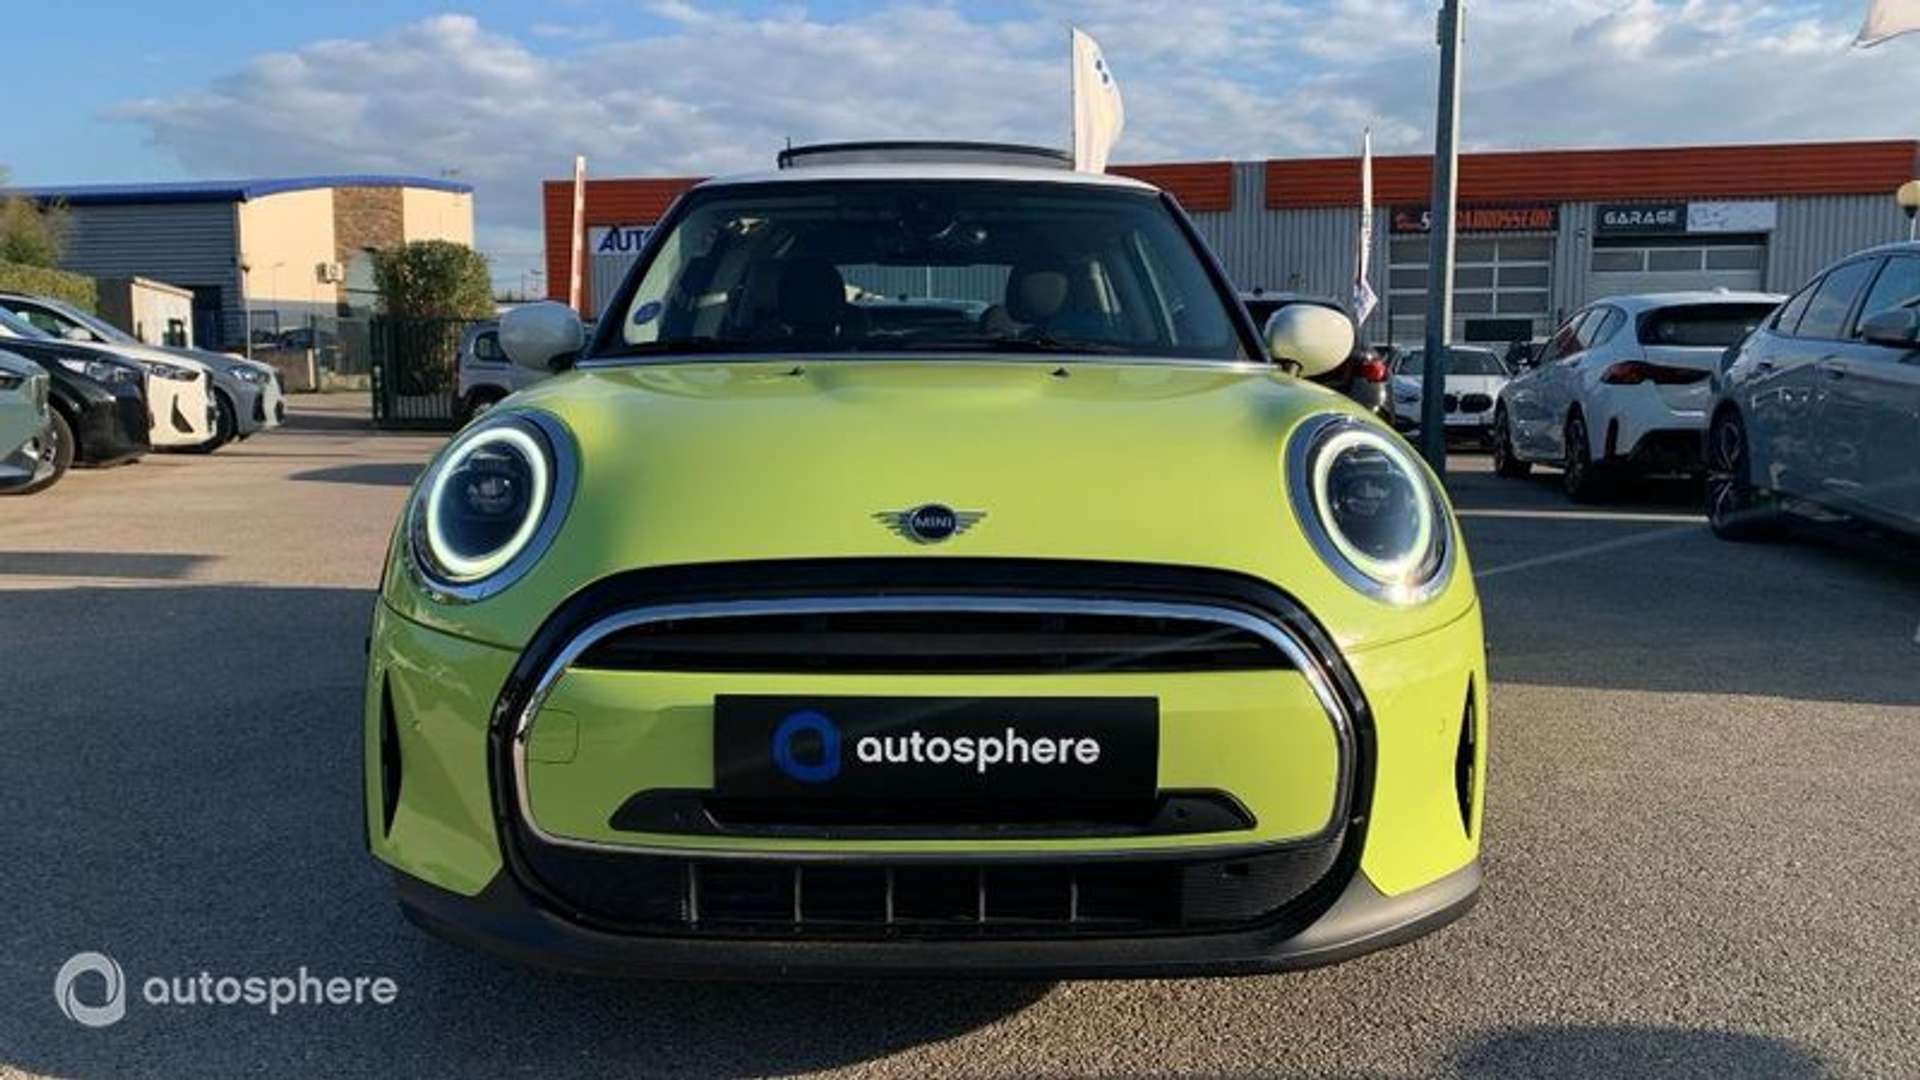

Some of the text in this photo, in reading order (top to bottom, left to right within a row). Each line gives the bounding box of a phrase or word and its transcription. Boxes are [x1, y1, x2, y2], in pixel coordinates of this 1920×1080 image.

[1603, 209, 1677, 225] GARAGE
[598, 228, 653, 252] AUT
[914, 516, 953, 528] MINI
[856, 727, 1101, 773] autosphere
